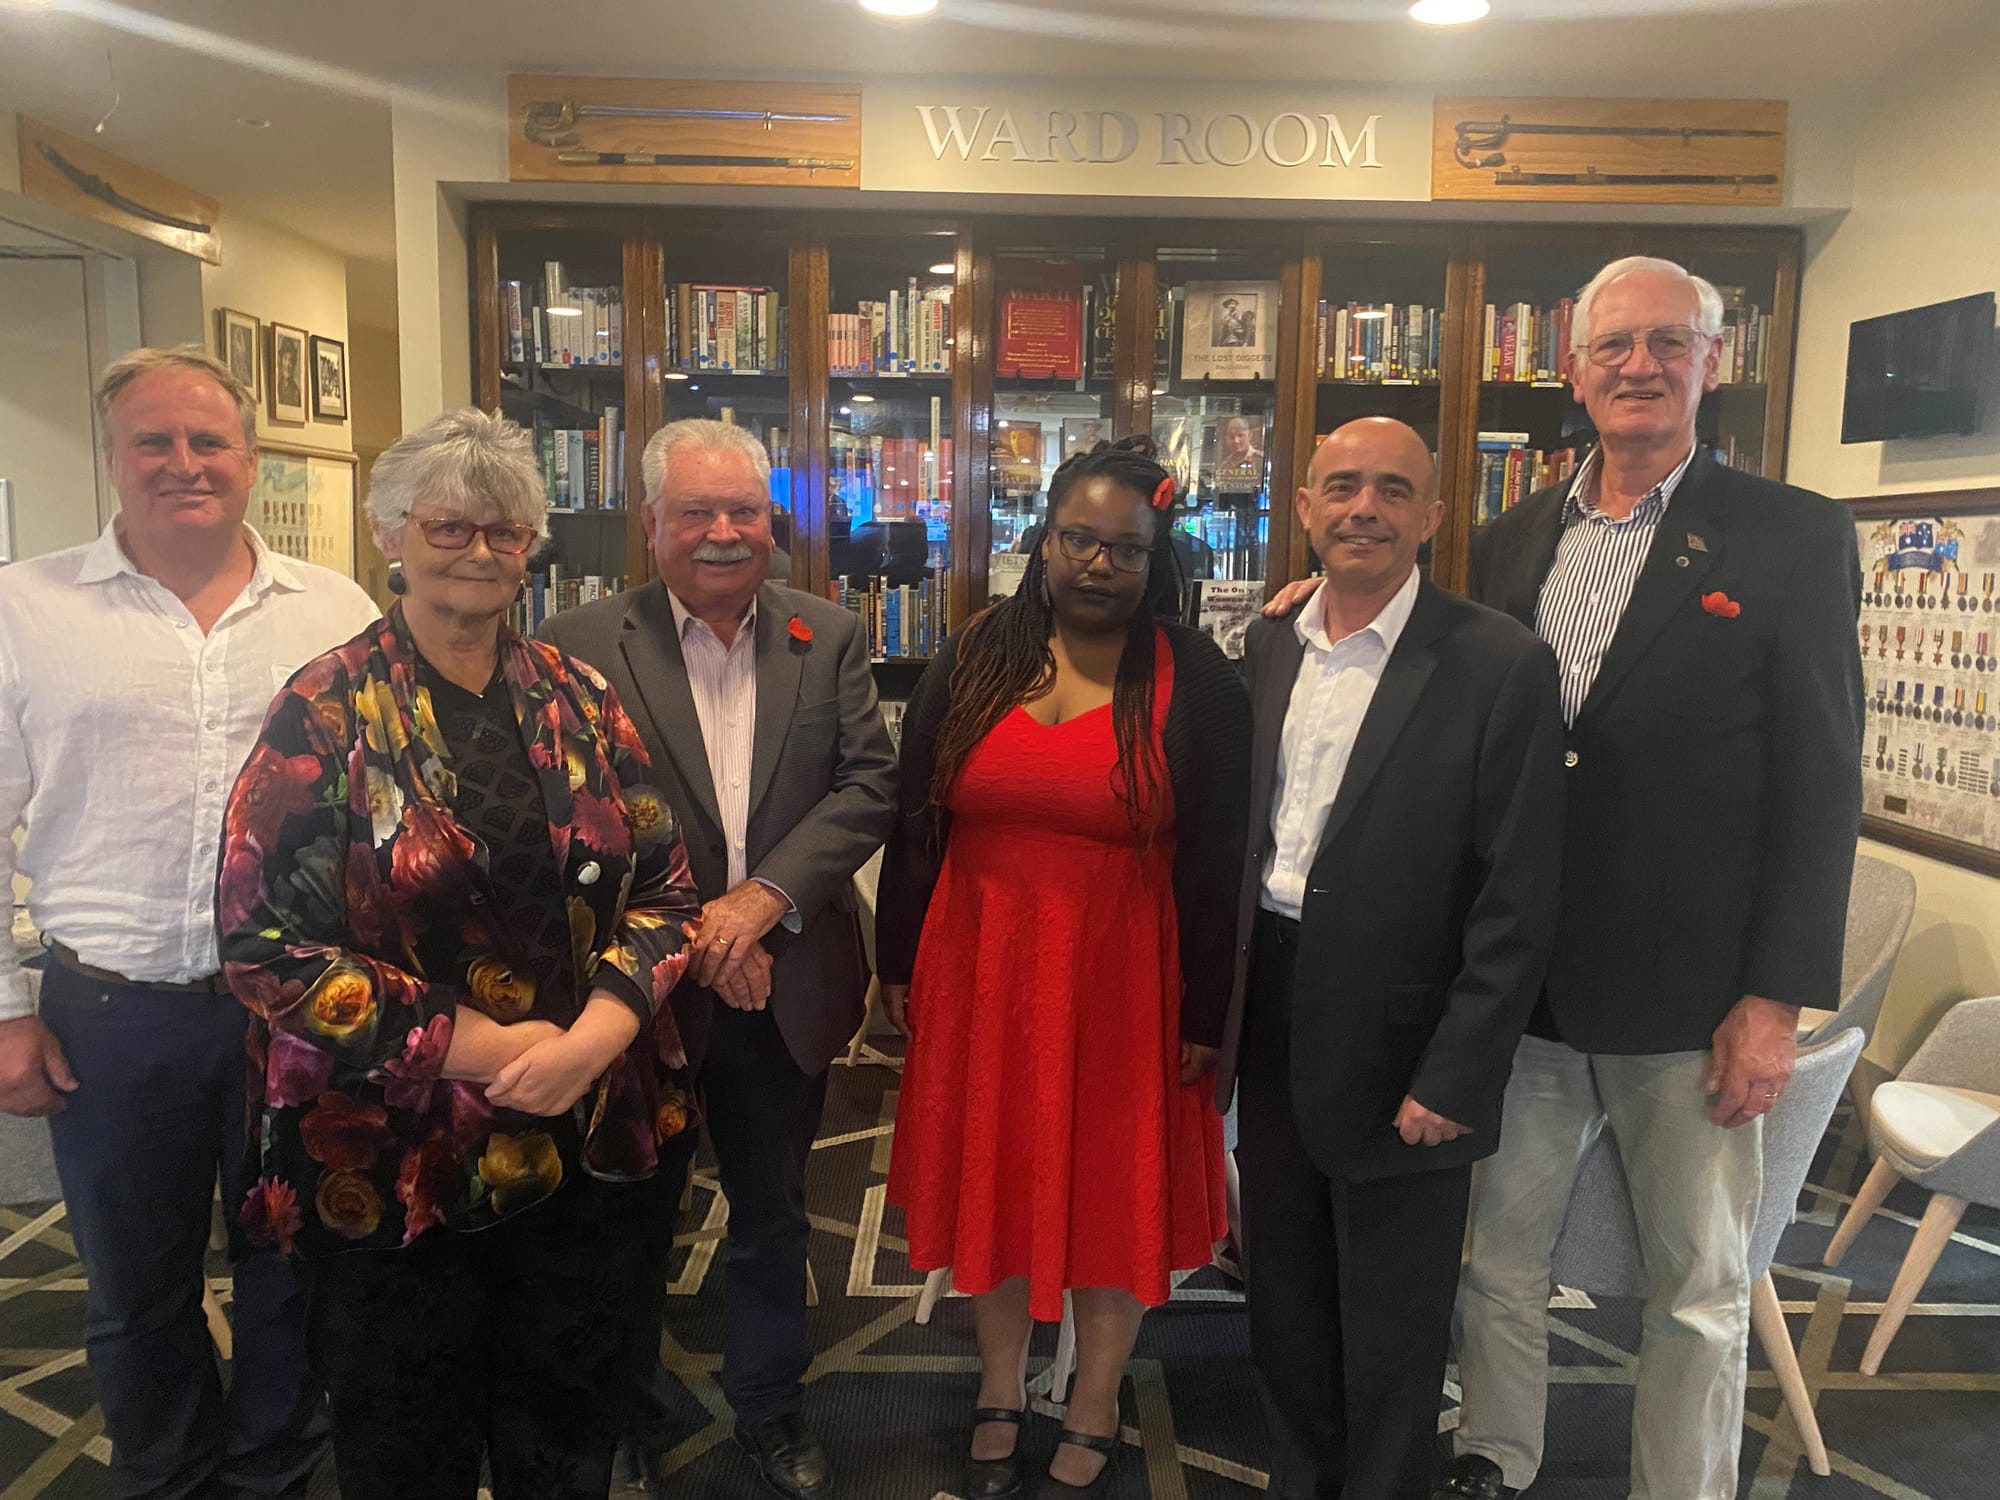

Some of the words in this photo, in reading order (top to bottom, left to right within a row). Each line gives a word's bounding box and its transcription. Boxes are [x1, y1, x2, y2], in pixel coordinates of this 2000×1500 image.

[915, 105, 1140, 165] WARD
[1154, 111, 1385, 168] ROOM
[1193, 354, 1209, 362] THE
[1212, 354, 1234, 362] LOST
[1236, 354, 1273, 362] DIGGERS
[1504, 334, 1515, 366] WEARY
[556, 433, 565, 470] KOKODA
[590, 447, 599, 491] HELLFIRE
[1216, 468, 1258, 476] GENERAL
[1231, 586, 1254, 594] Ony
